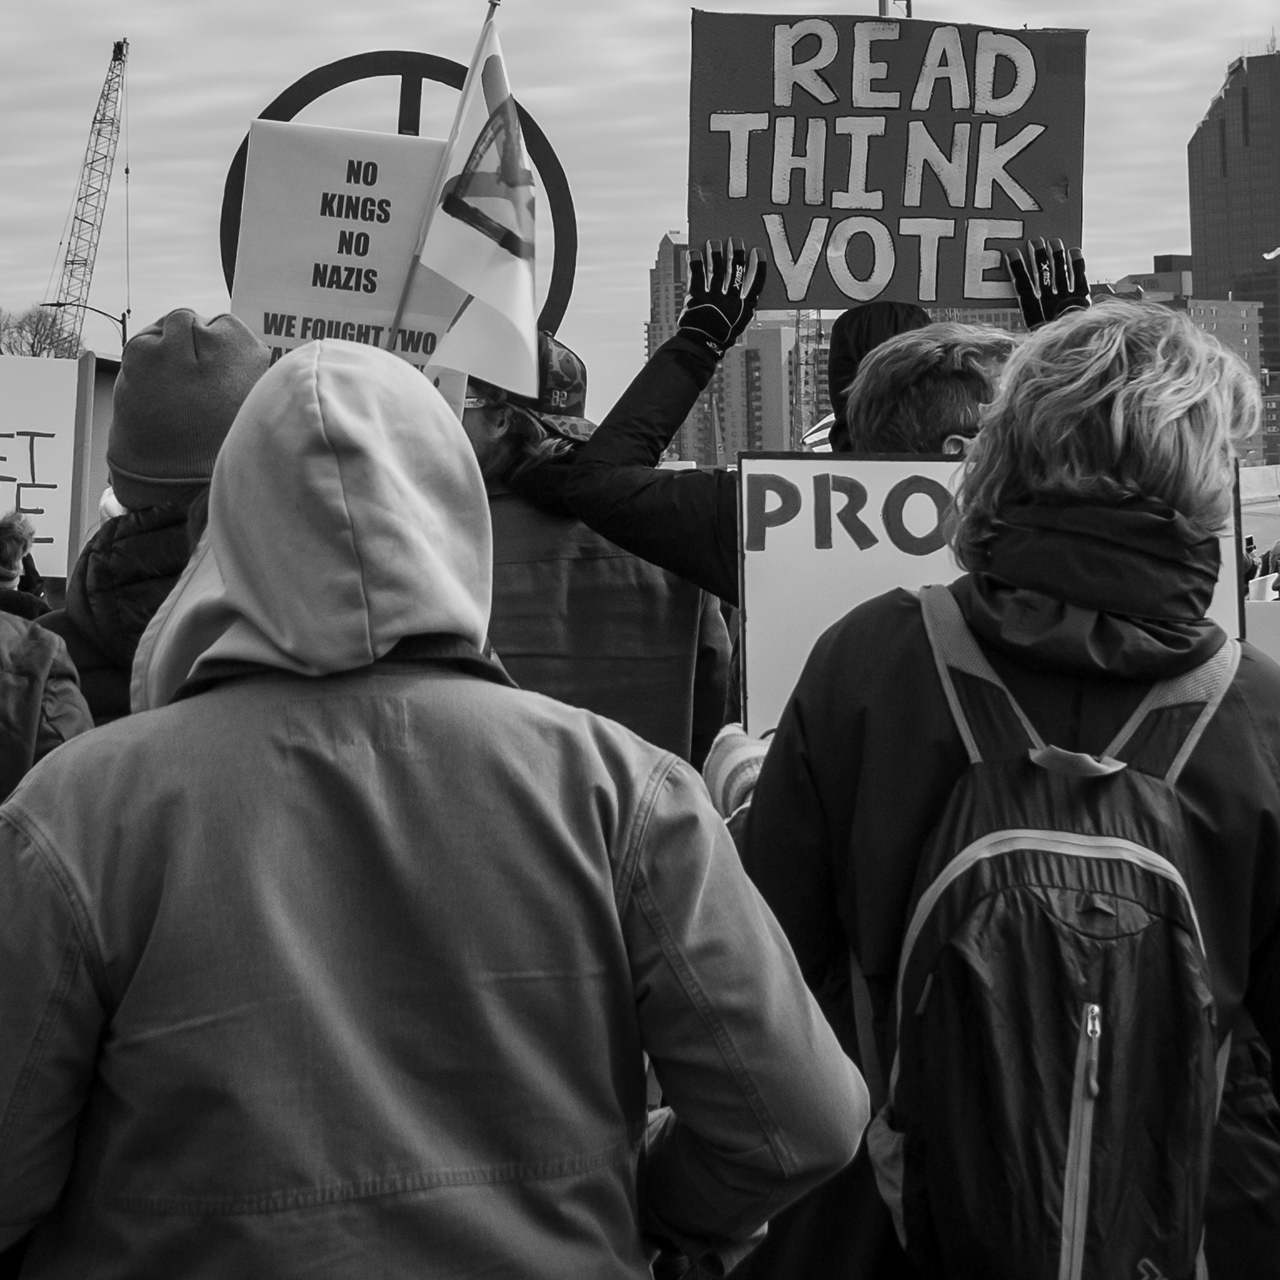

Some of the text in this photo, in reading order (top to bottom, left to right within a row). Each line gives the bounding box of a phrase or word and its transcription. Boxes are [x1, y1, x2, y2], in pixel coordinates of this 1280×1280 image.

[773, 19, 1037, 118] READ
[346, 159, 379, 187] NO
[709, 111, 1049, 212] THINK
[320, 192, 391, 224] KINGS
[337, 230, 370, 257] NO
[762, 214, 1024, 302] VOTE
[312, 263, 378, 294] NAZIS
[263, 312, 437, 355] WE FOUGHT TWO
